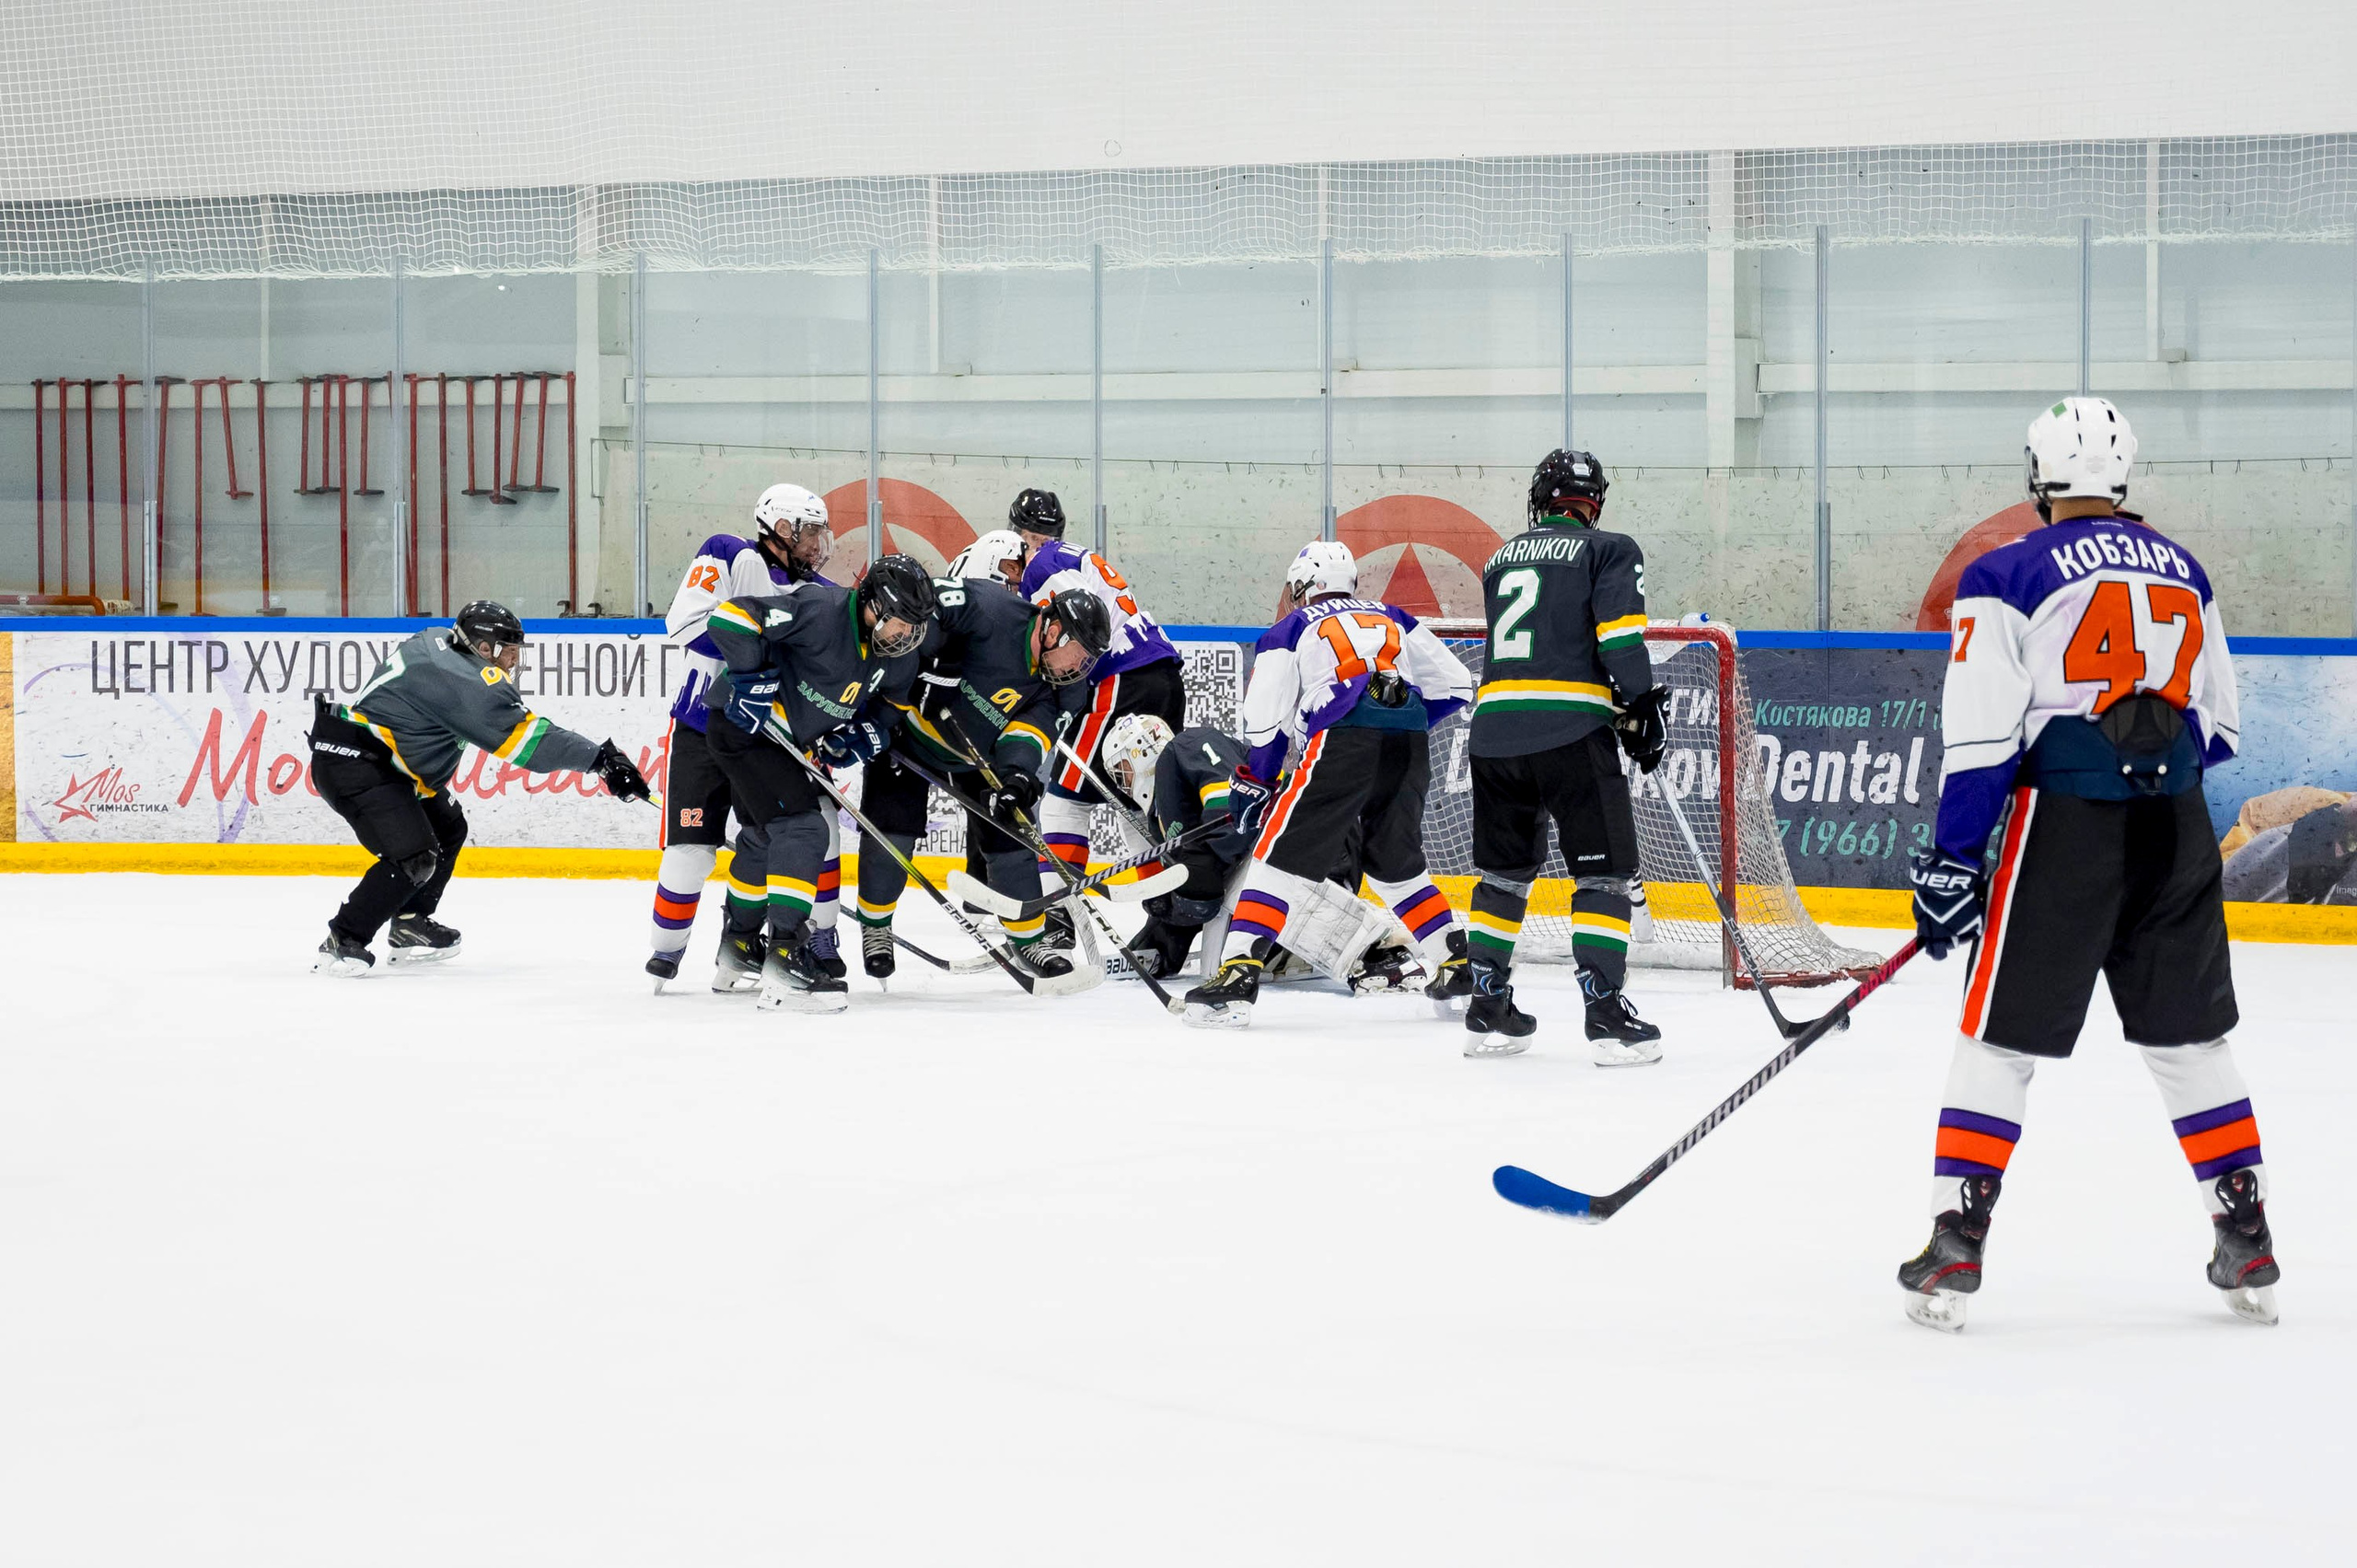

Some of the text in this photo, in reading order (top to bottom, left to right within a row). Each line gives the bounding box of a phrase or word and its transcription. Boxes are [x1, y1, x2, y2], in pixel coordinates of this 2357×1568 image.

[2050, 533, 2190, 580] КОБЗАРЬ
[686, 565, 720, 594] 82
[764, 608, 793, 629] 4
[1491, 566, 1542, 663] 2
[1317, 612, 1401, 683] 17
[1949, 616, 1976, 663] 7
[2063, 580, 2204, 714] 47
[91, 640, 229, 700] ЦЕНТР
[242, 632, 645, 701] ХУДОЕННОЙ
[1755, 698, 1872, 728] Костякова
[314, 741, 361, 758] BAUER
[1202, 742, 1221, 766] 1
[1745, 734, 1925, 805] Dental
[89, 804, 168, 812] ГИМНАСТИКА
[680, 807, 703, 827] 82
[1799, 816, 1898, 860] (966)
[1910, 867, 1972, 890] UER
